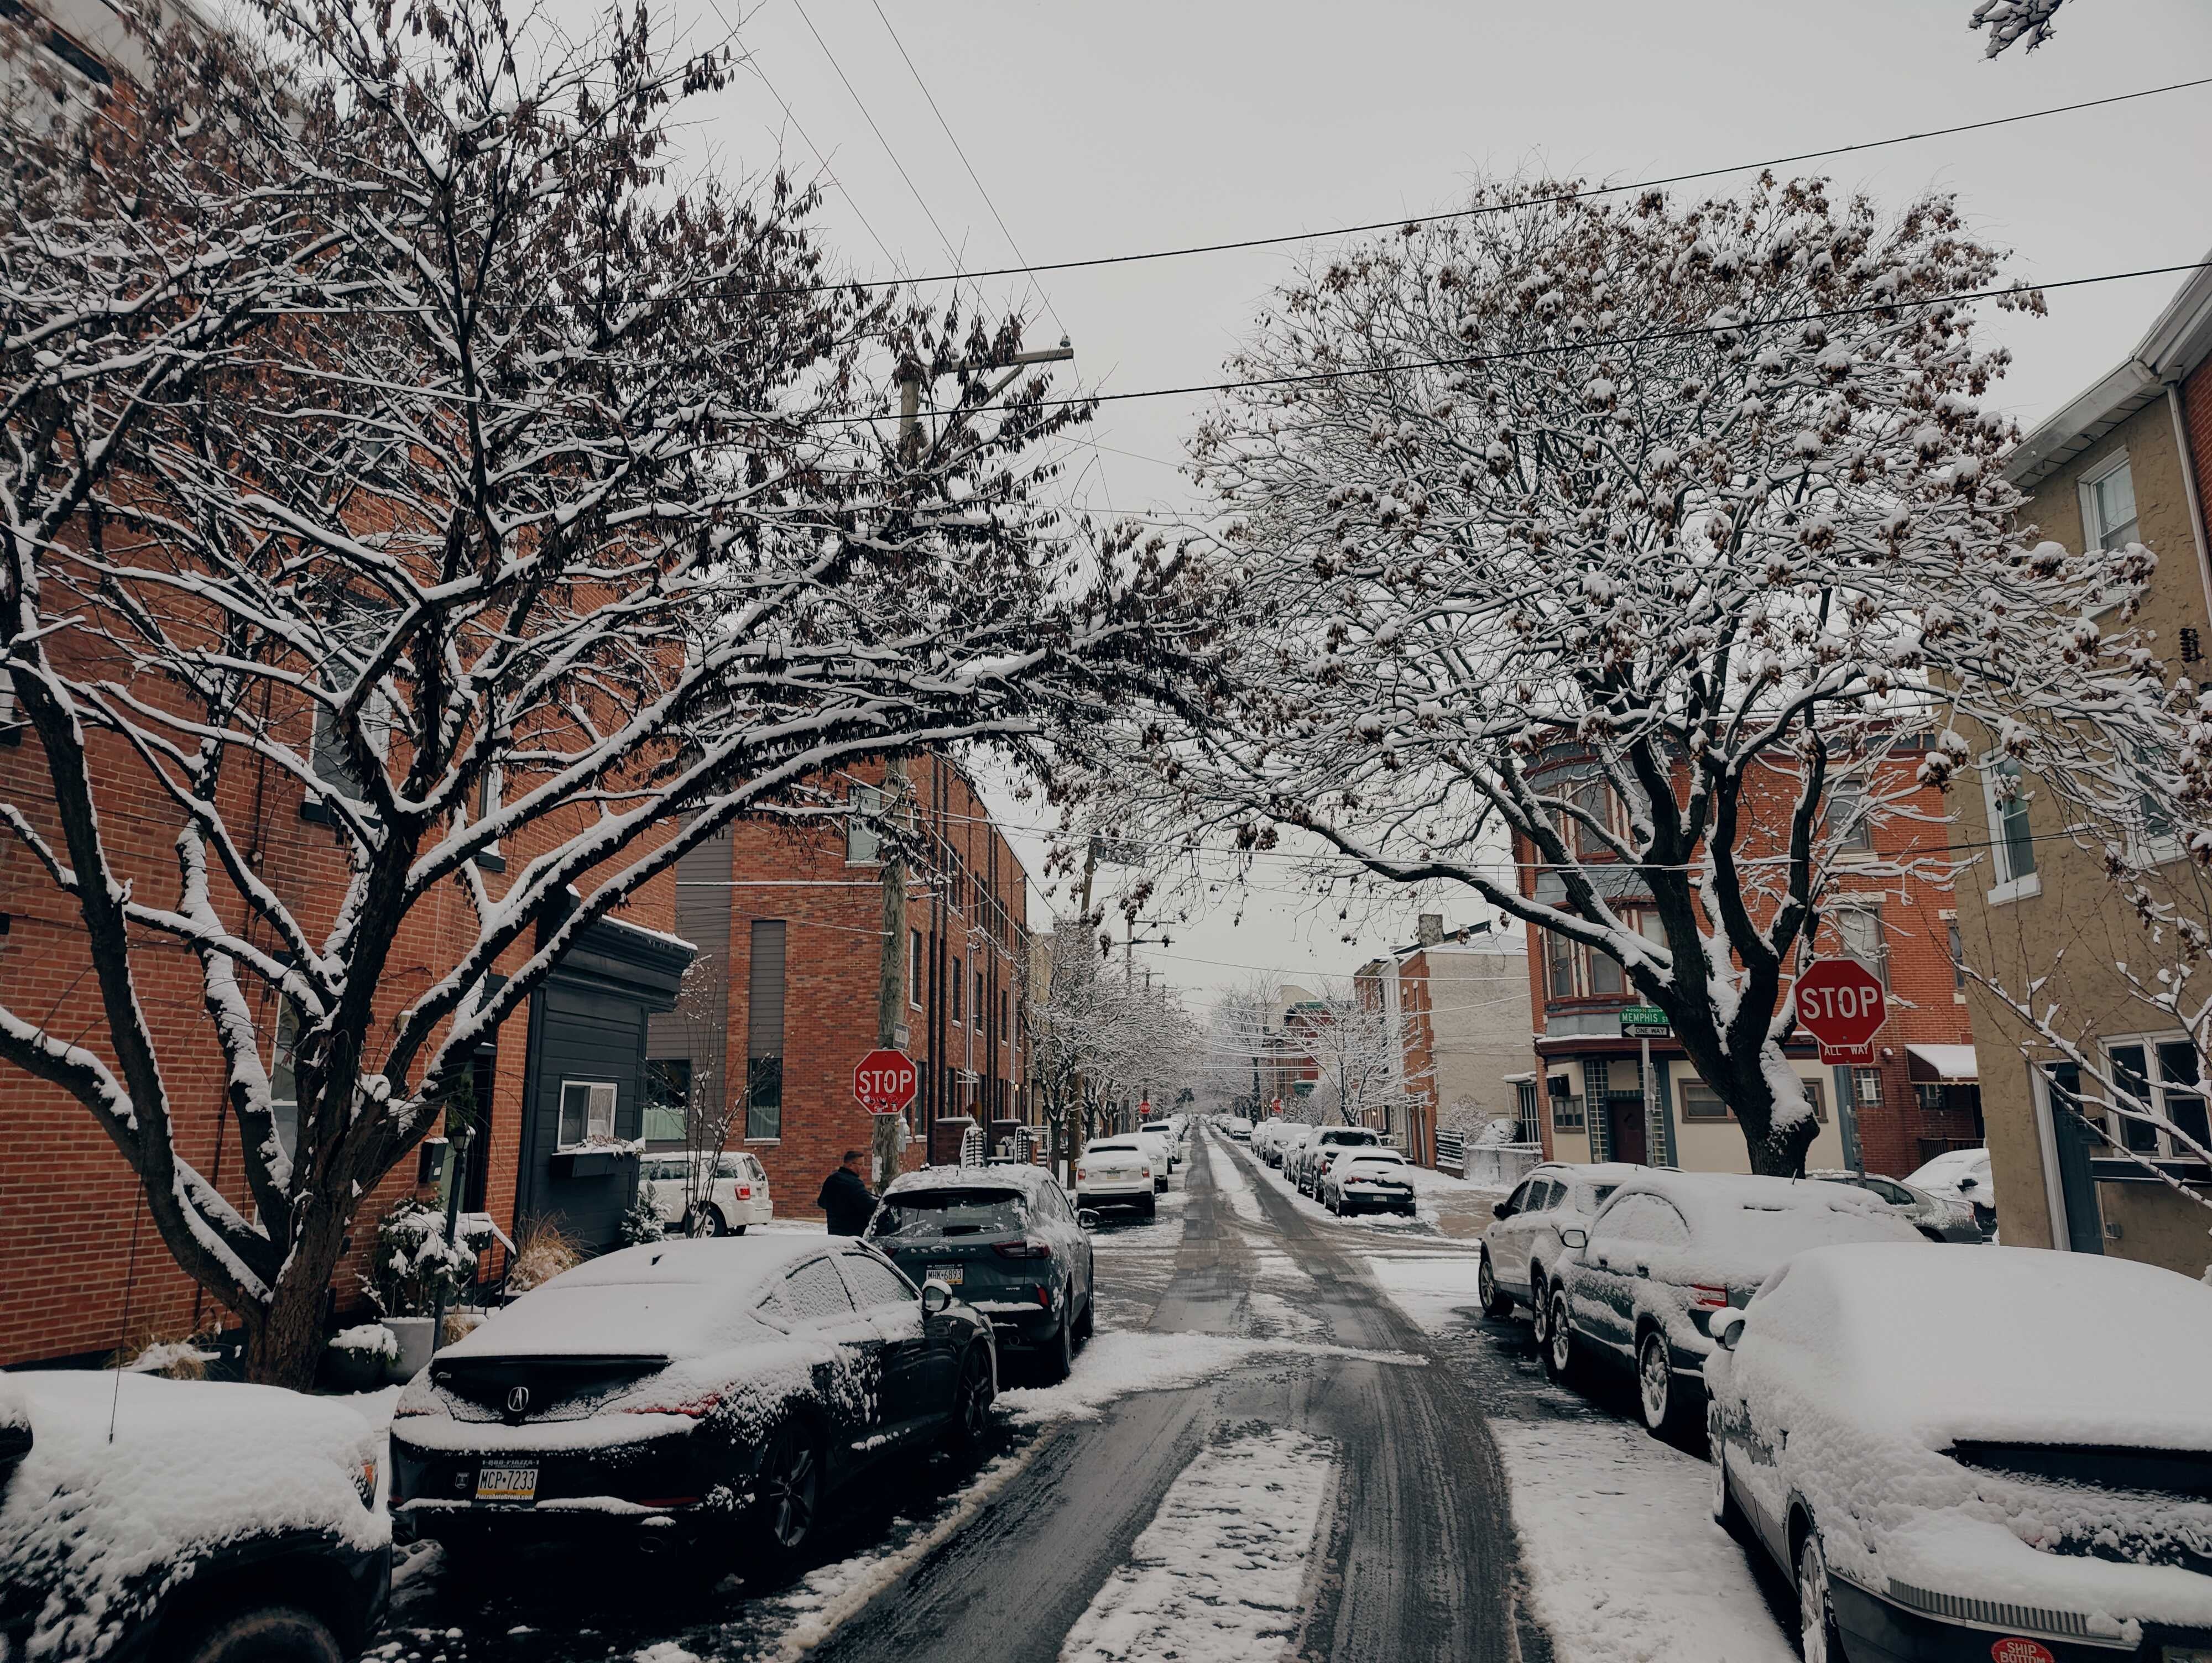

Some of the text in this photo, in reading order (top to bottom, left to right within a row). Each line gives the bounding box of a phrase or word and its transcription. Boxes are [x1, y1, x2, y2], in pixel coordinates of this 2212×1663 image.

[1801, 986, 1878, 1019] STOP
[1622, 1012, 1658, 1022] MEMPHIS
[1824, 1045, 1869, 1056] ALL WAY
[858, 1070, 912, 1094] STOP
[2006, 1641, 2037, 1656] SHIP
